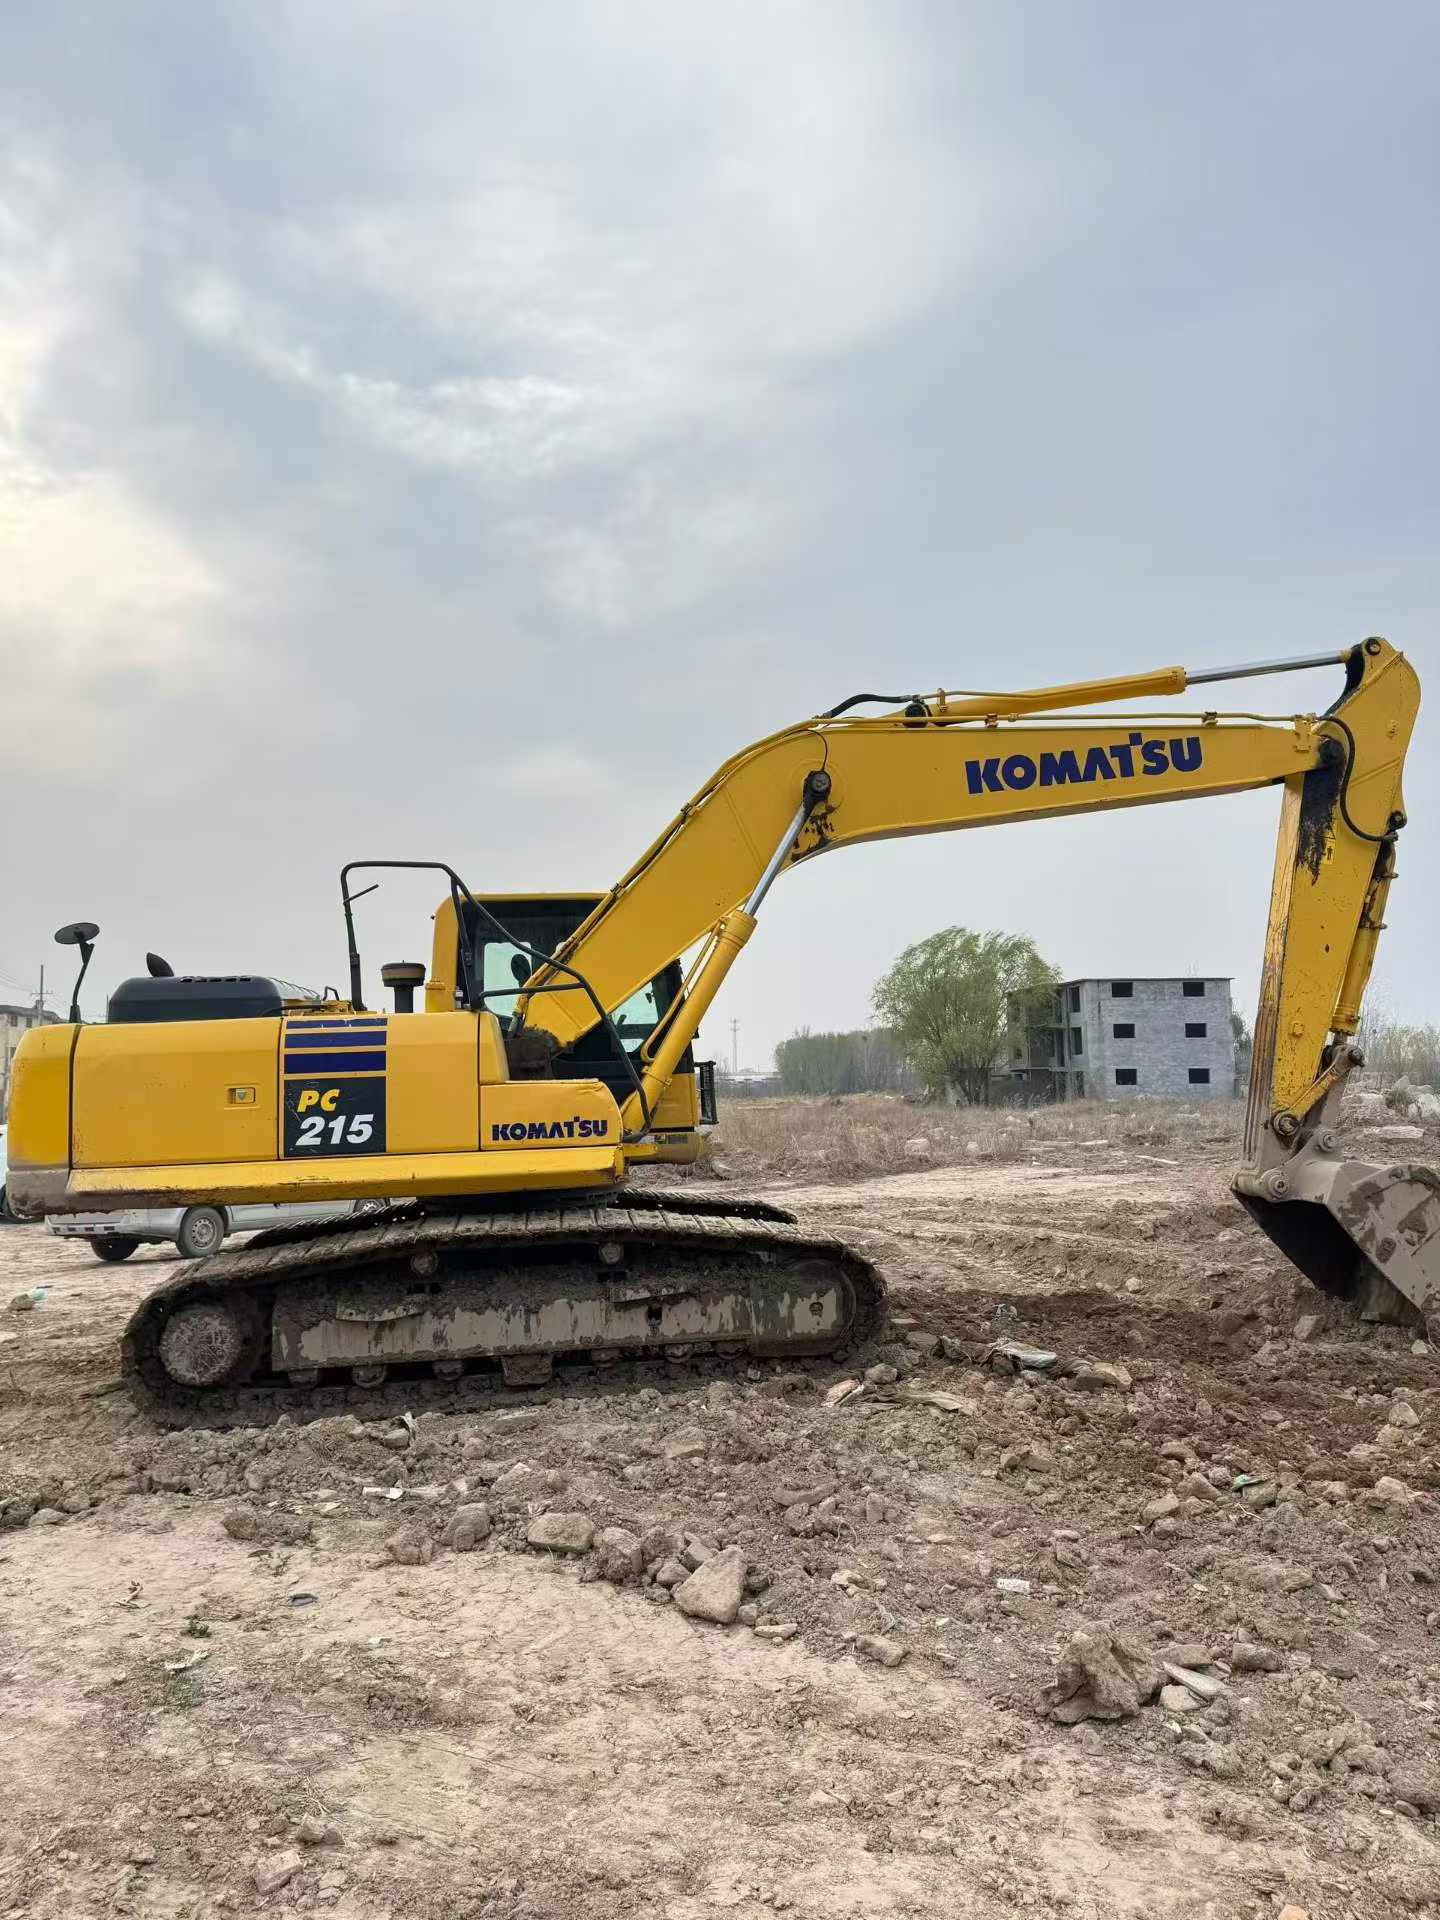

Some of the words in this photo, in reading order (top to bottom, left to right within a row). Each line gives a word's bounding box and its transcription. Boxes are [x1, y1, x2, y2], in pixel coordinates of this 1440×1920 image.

[965, 733, 1203, 794] KOMATSU
[297, 1089, 340, 1112] PC
[295, 1114, 374, 1146] 215
[492, 1116, 608, 1140] KOMATSU
